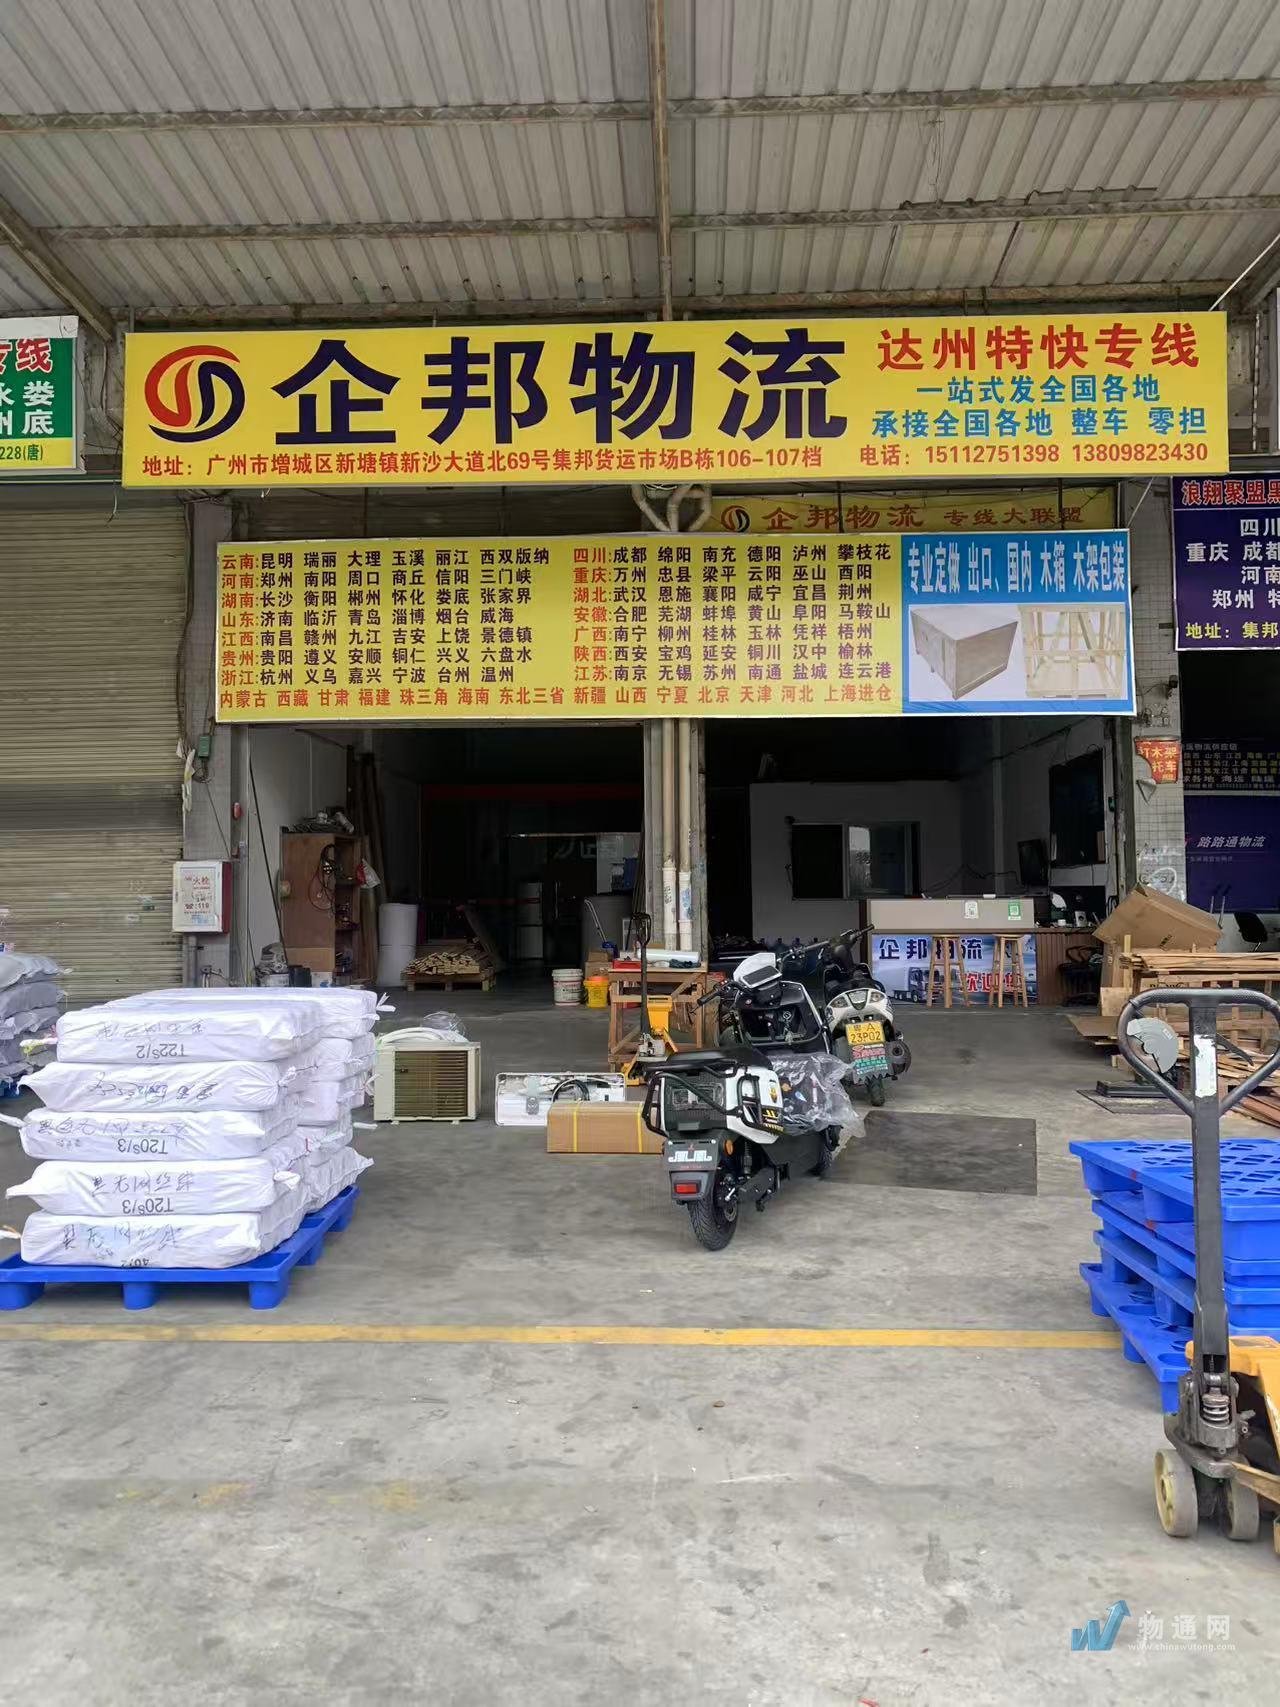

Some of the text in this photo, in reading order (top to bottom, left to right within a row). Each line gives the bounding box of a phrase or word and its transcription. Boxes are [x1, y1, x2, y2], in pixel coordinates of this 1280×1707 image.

[878, 322, 1199, 372] 达州特快专线
[271, 327, 847, 445] 企邦物流
[916, 373, 1161, 405] 一站式发全国各地
[871, 405, 1207, 439] 承接全国各地 整车 零担
[1073, 442, 1208, 463] 13809823430
[761, 503, 1085, 531] 企邦物流 专线大联盟
[304, 552, 337, 568] 瑞丽
[348, 551, 381, 566] 大理
[392, 550, 424, 566] 玉溪
[436, 550, 469, 565] 丽江
[480, 548, 548, 564] 西双版纳
[658, 547, 690, 563] 绵阳
[703, 546, 736, 562] 南充
[747, 546, 780, 562] 德阳
[793, 545, 826, 561] 泸州
[838, 544, 891, 560] 攀枝花
[1185, 542, 1230, 563] 重庆
[658, 566, 691, 582] 忠县
[703, 566, 736, 582] 梁平
[748, 566, 780, 581] 云阳
[793, 565, 825, 580] 巫山
[838, 564, 871, 580] 酉阳
[907, 541, 961, 595] 专业定做
[1040, 540, 1066, 593] 木箱
[1072, 539, 1126, 593] 木架包装
[304, 572, 336, 587] 南阳
[348, 571, 379, 586] 周口
[392, 570, 425, 586] 商丘
[436, 569, 468, 585] 信阳
[480, 568, 531, 584] 三门峡
[304, 591, 336, 607] 衡阳
[348, 590, 380, 606] 郴州
[392, 589, 425, 605] 怀化
[436, 588, 469, 605] 娄底
[481, 588, 531, 604] 张家界
[658, 586, 691, 602] 恩施
[703, 586, 735, 602] 襄阳
[748, 585, 781, 601] 咸宁
[793, 584, 826, 600] 宜昌
[838, 583, 871, 600] 荆州
[1212, 589, 1254, 609] 郑州
[304, 610, 337, 626] 临沂
[348, 609, 380, 626] 青岛
[392, 608, 425, 625] 淄博
[436, 608, 469, 624] 烟台
[481, 607, 513, 623] 威海
[659, 606, 691, 622] 芜湖
[703, 605, 736, 622] 蚌埠
[748, 605, 780, 621] 黄山
[793, 604, 826, 620] 阜阳
[839, 603, 890, 619] 马鞍山
[304, 629, 336, 645] 赣州
[349, 629, 381, 644] 九江
[393, 628, 425, 644] 吉安
[437, 627, 470, 643] 上饶
[481, 627, 532, 643] 景德镇
[658, 625, 690, 642] 柳州
[703, 625, 736, 641] 桂林
[748, 624, 781, 640] 玉林
[793, 623, 827, 640] 凭祥
[838, 623, 871, 639] 梧州
[304, 649, 337, 665] 遵义
[349, 648, 381, 664] 安顺
[392, 648, 425, 664] 铜仁
[437, 648, 469, 663] 兴义
[481, 646, 531, 662] 六盘水
[659, 645, 691, 661] 宝鸡
[703, 645, 736, 661] 延安
[748, 644, 780, 660] 铜川
[793, 643, 826, 660] 汉中
[838, 642, 872, 659] 榆林
[305, 668, 336, 684] 义乌
[349, 667, 381, 684] 嘉兴
[393, 667, 425, 683] 宁波
[438, 667, 469, 683] 台州
[481, 667, 513, 682] 温州
[659, 665, 691, 681] 无锡
[703, 664, 735, 680] 苏州
[748, 664, 781, 680] 南通
[793, 663, 827, 679] 盐城
[839, 662, 891, 679] 连云港
[221, 684, 891, 708] 内蒙古 西藏 甘肃 福建 珠三角 海南 东北三省 新疆 山西 宁夏 北京 天津 河北 上海进仓
[1197, 836, 1267, 848] 路路通物流
